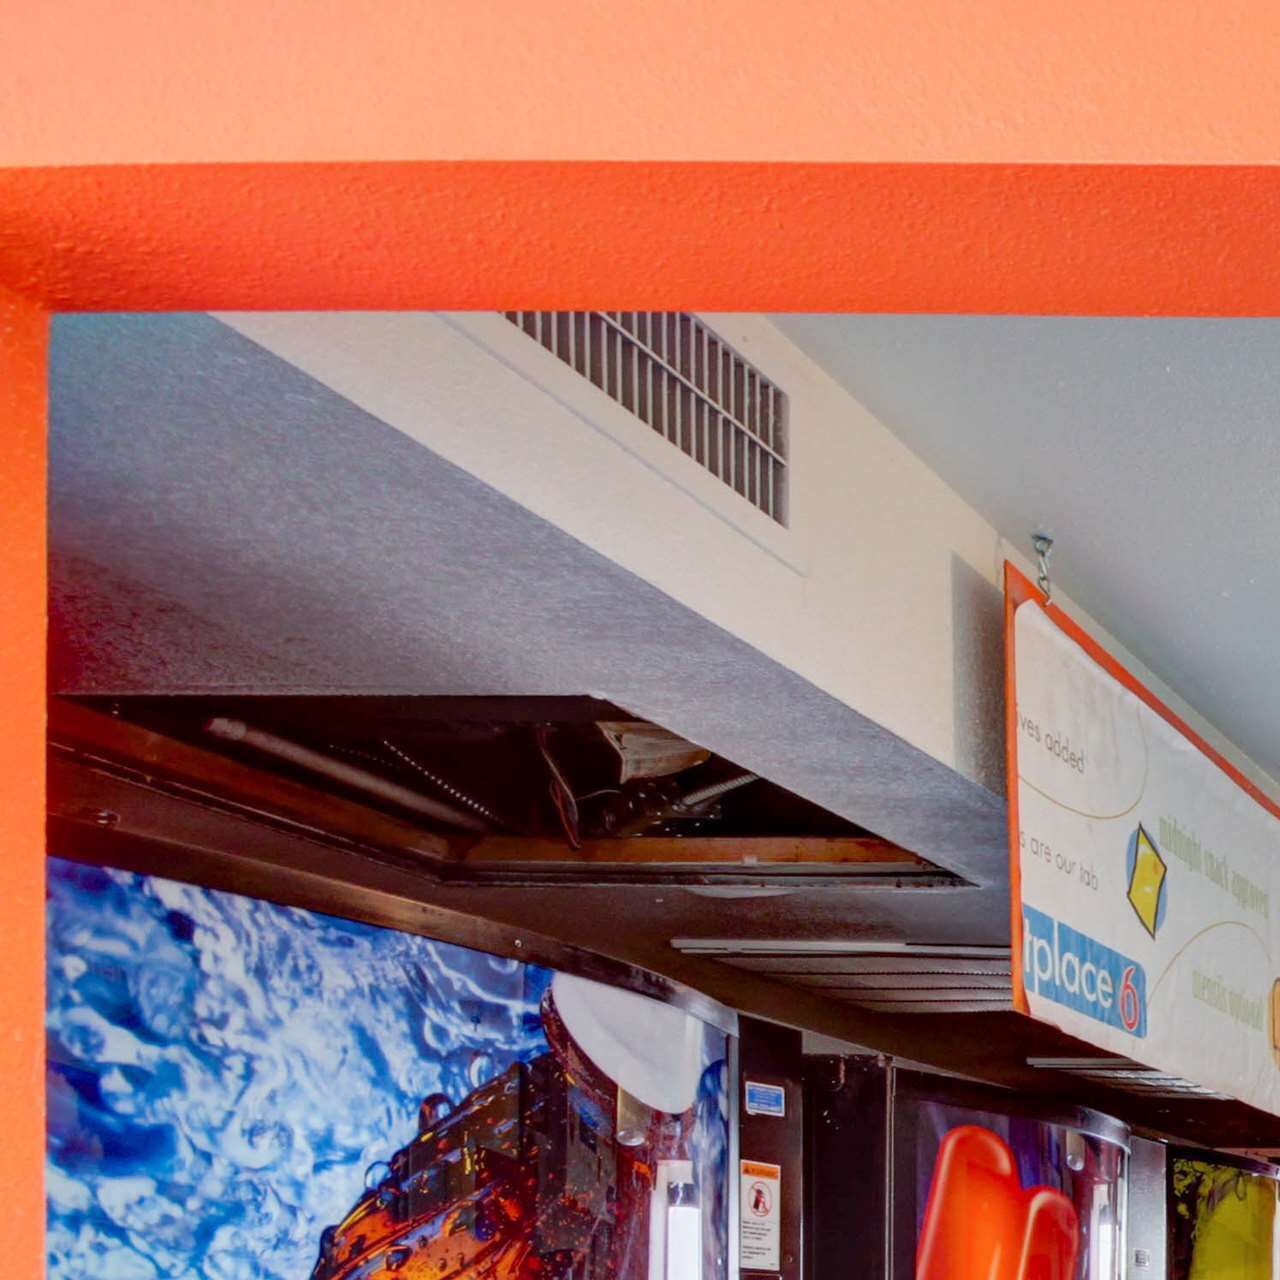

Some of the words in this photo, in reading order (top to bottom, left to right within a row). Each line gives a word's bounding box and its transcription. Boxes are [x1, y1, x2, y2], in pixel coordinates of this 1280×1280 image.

[1045, 733, 1085, 774] added
[1031, 838, 1052, 863] are
[1056, 853, 1077, 874] our
[1120, 966, 1139, 1031] 6
